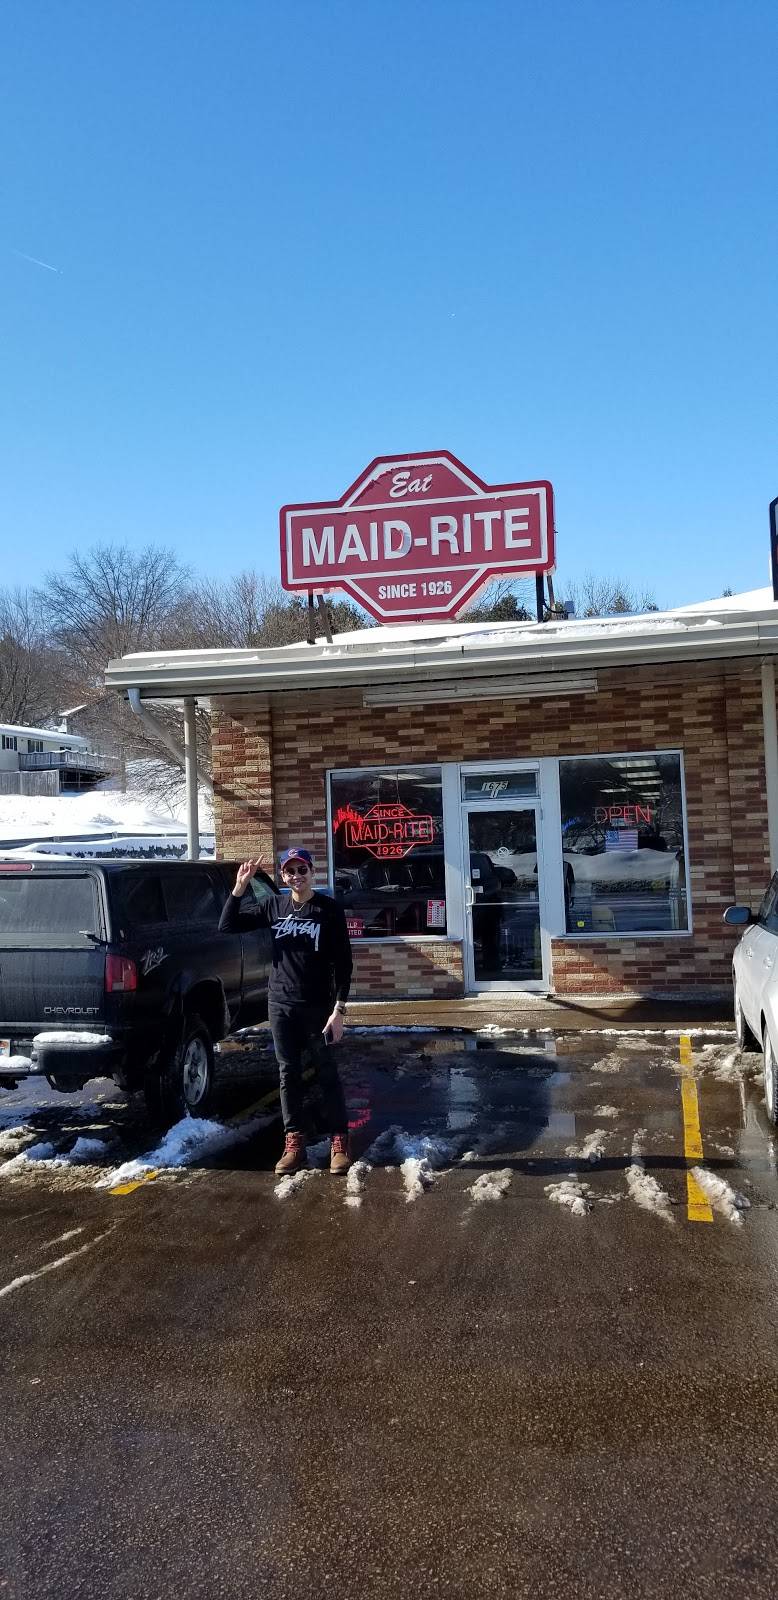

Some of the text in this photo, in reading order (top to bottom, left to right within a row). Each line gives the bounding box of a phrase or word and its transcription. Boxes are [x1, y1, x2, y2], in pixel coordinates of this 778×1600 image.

[389, 471, 433, 498] Eat
[301, 507, 532, 567] MAID-RITE
[378, 580, 452, 600] SINCE 1926
[481, 780, 509, 791] 1675
[372, 808, 406, 818] SINCE
[594, 805, 651, 824] OPEN
[350, 821, 429, 842] MAID-RITE
[376, 846, 403, 855] 1926
[43, 1006, 100, 1015] CHEVROLET
